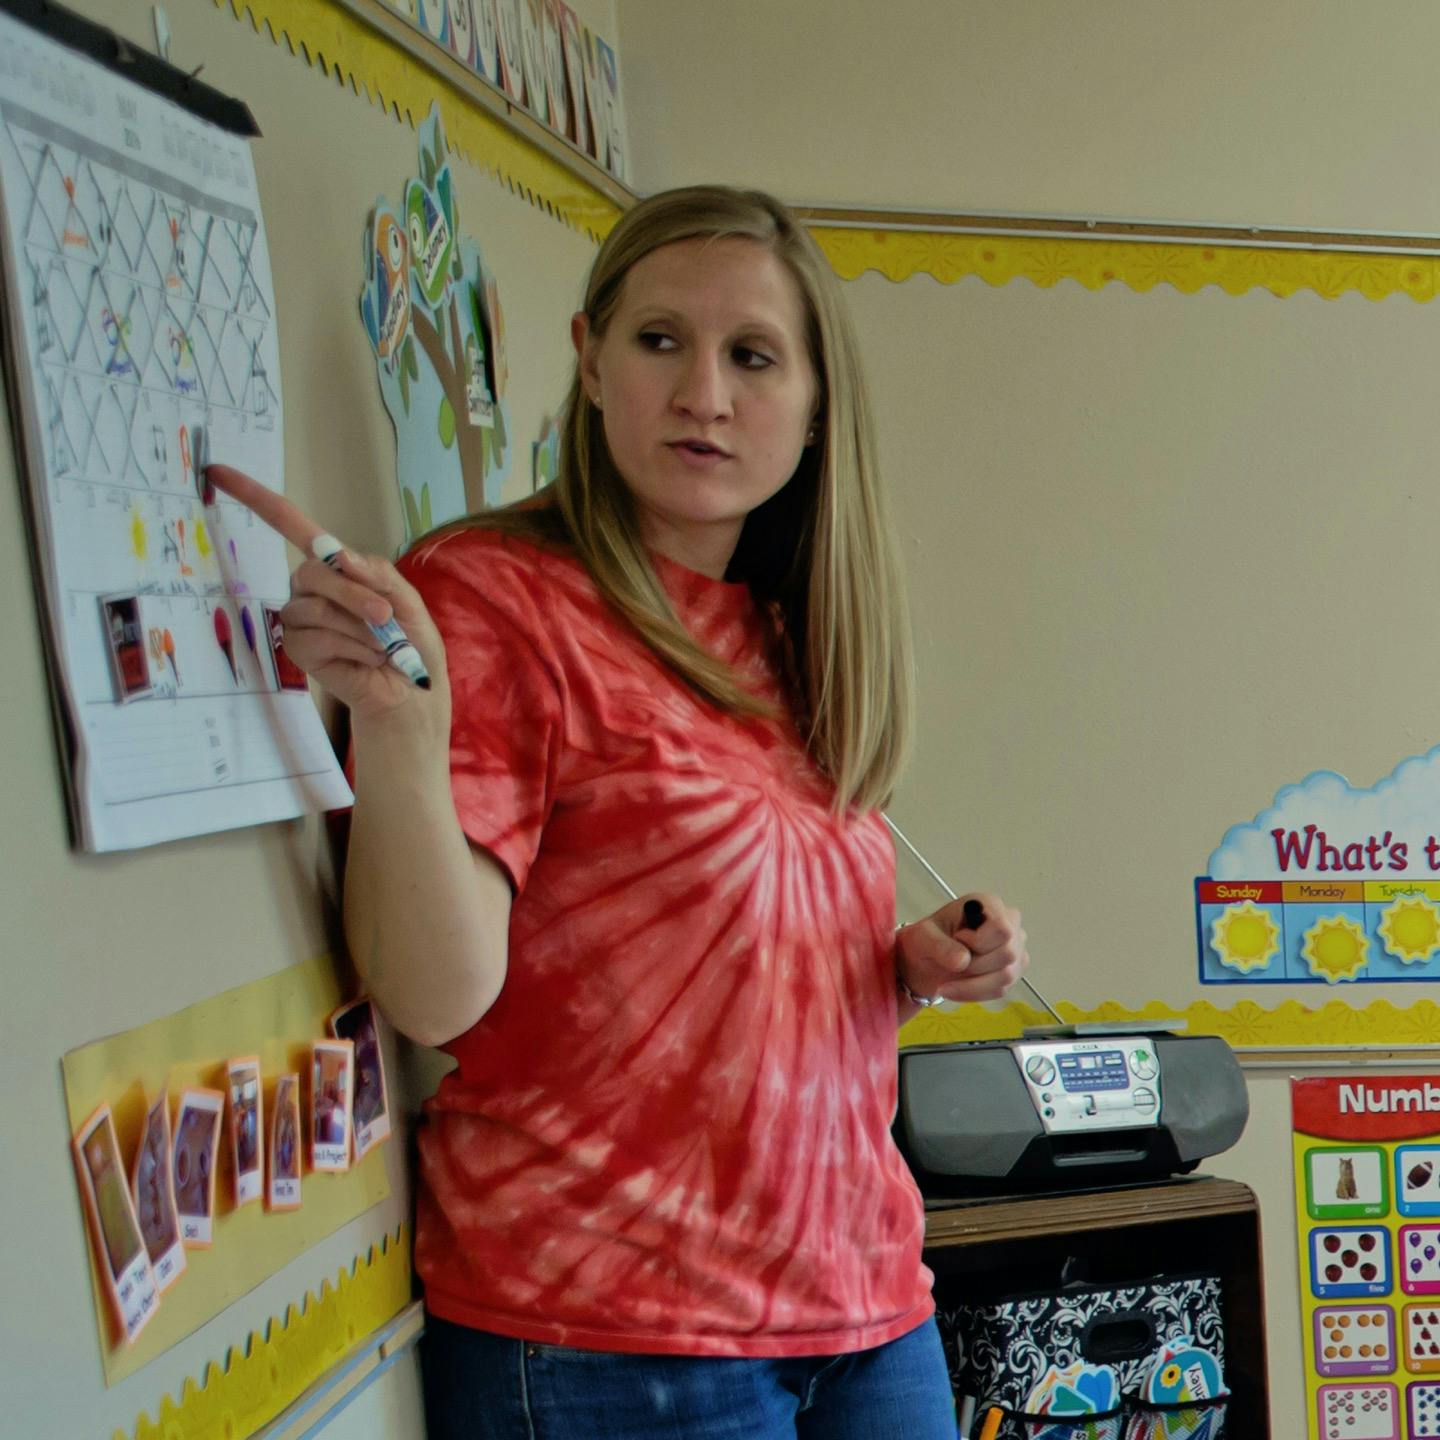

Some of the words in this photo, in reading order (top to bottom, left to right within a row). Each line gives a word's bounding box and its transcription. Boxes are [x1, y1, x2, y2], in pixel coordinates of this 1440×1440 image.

[1271, 824, 1408, 872] What's
[1216, 885, 1263, 900] Sunday
[1300, 885, 1346, 899] Monday
[1364, 1205, 1382, 1215] one
[1318, 1286, 1326, 1295] 5
[1368, 1284, 1386, 1293] five
[1407, 1283, 1415, 1292] 6
